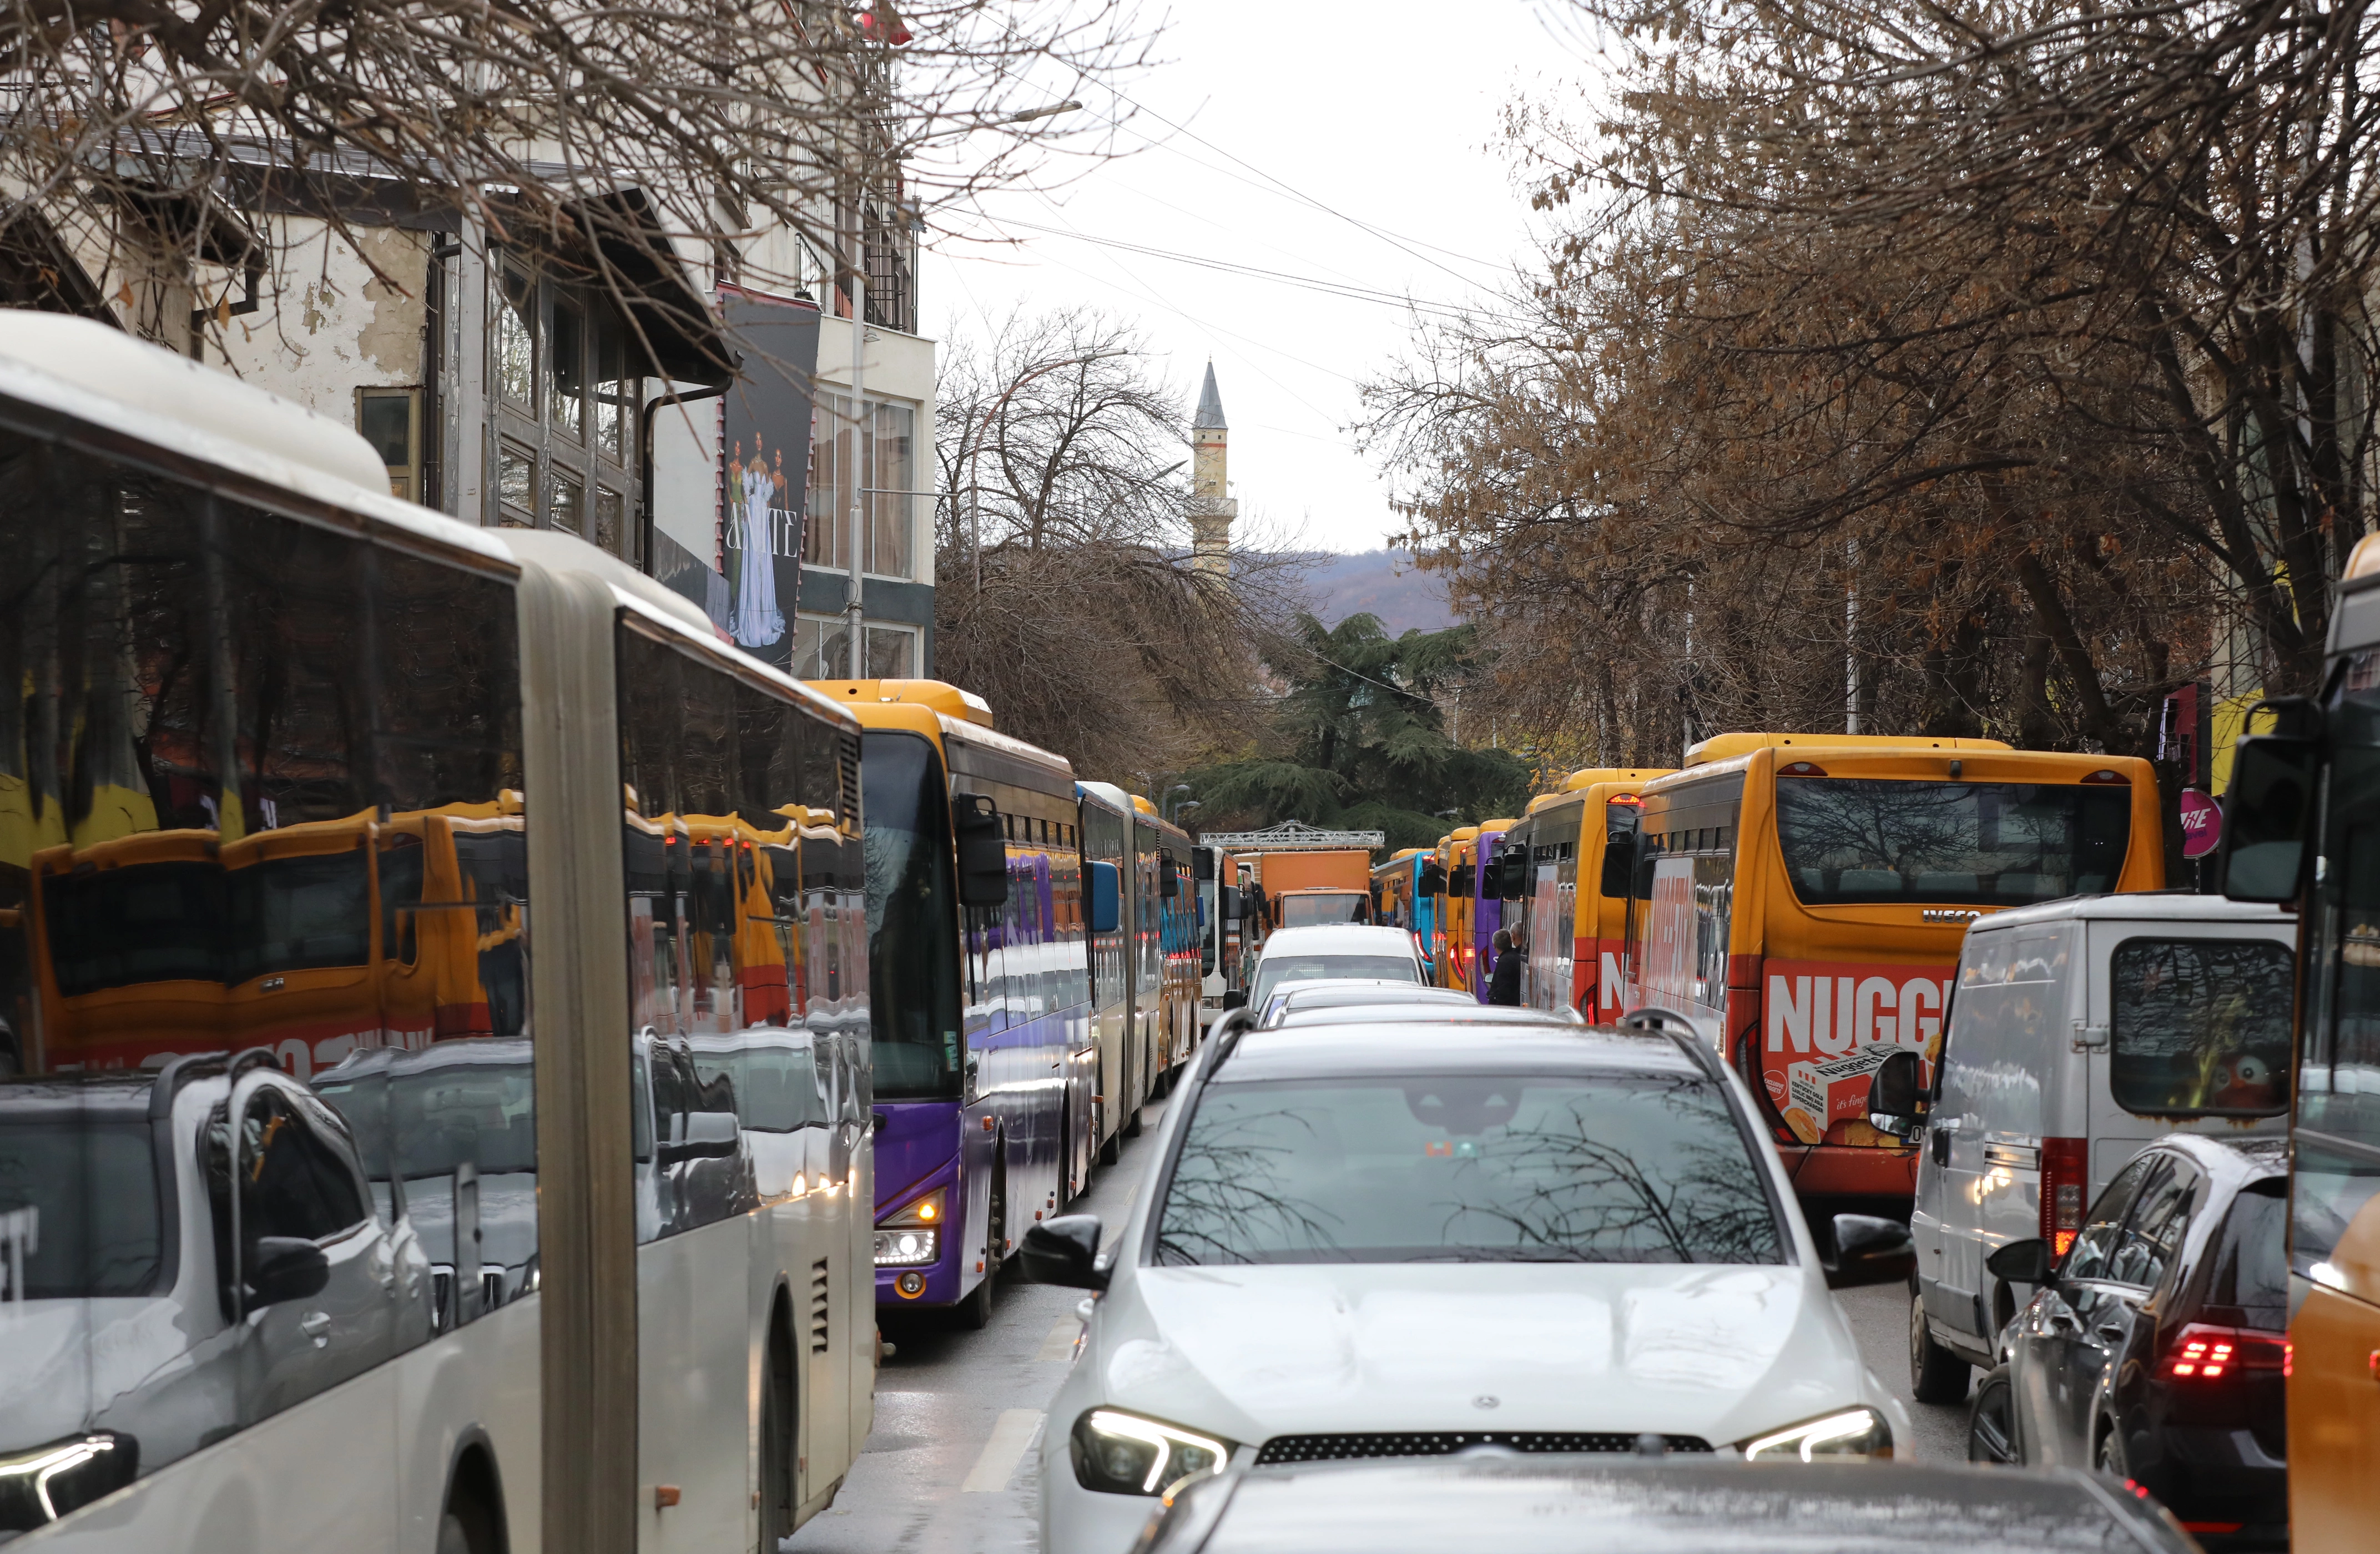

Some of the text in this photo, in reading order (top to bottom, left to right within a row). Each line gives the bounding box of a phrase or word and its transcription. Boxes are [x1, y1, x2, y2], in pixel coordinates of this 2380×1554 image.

[2186, 829, 2207, 840] avel
[1923, 910, 1981, 923] IVECO
[1816, 1056, 1884, 1077] Nuggets
[1764, 1078, 1784, 1089] EXCLUSIVE
[1792, 1081, 1812, 1096] KENTUCKY
[1812, 1092, 1823, 1101] GOLD
[1792, 1087, 1805, 1098] GARLIC
[1792, 1093, 1823, 1114] SUPERCHARGER
[1848, 1094, 1868, 1108] finge
